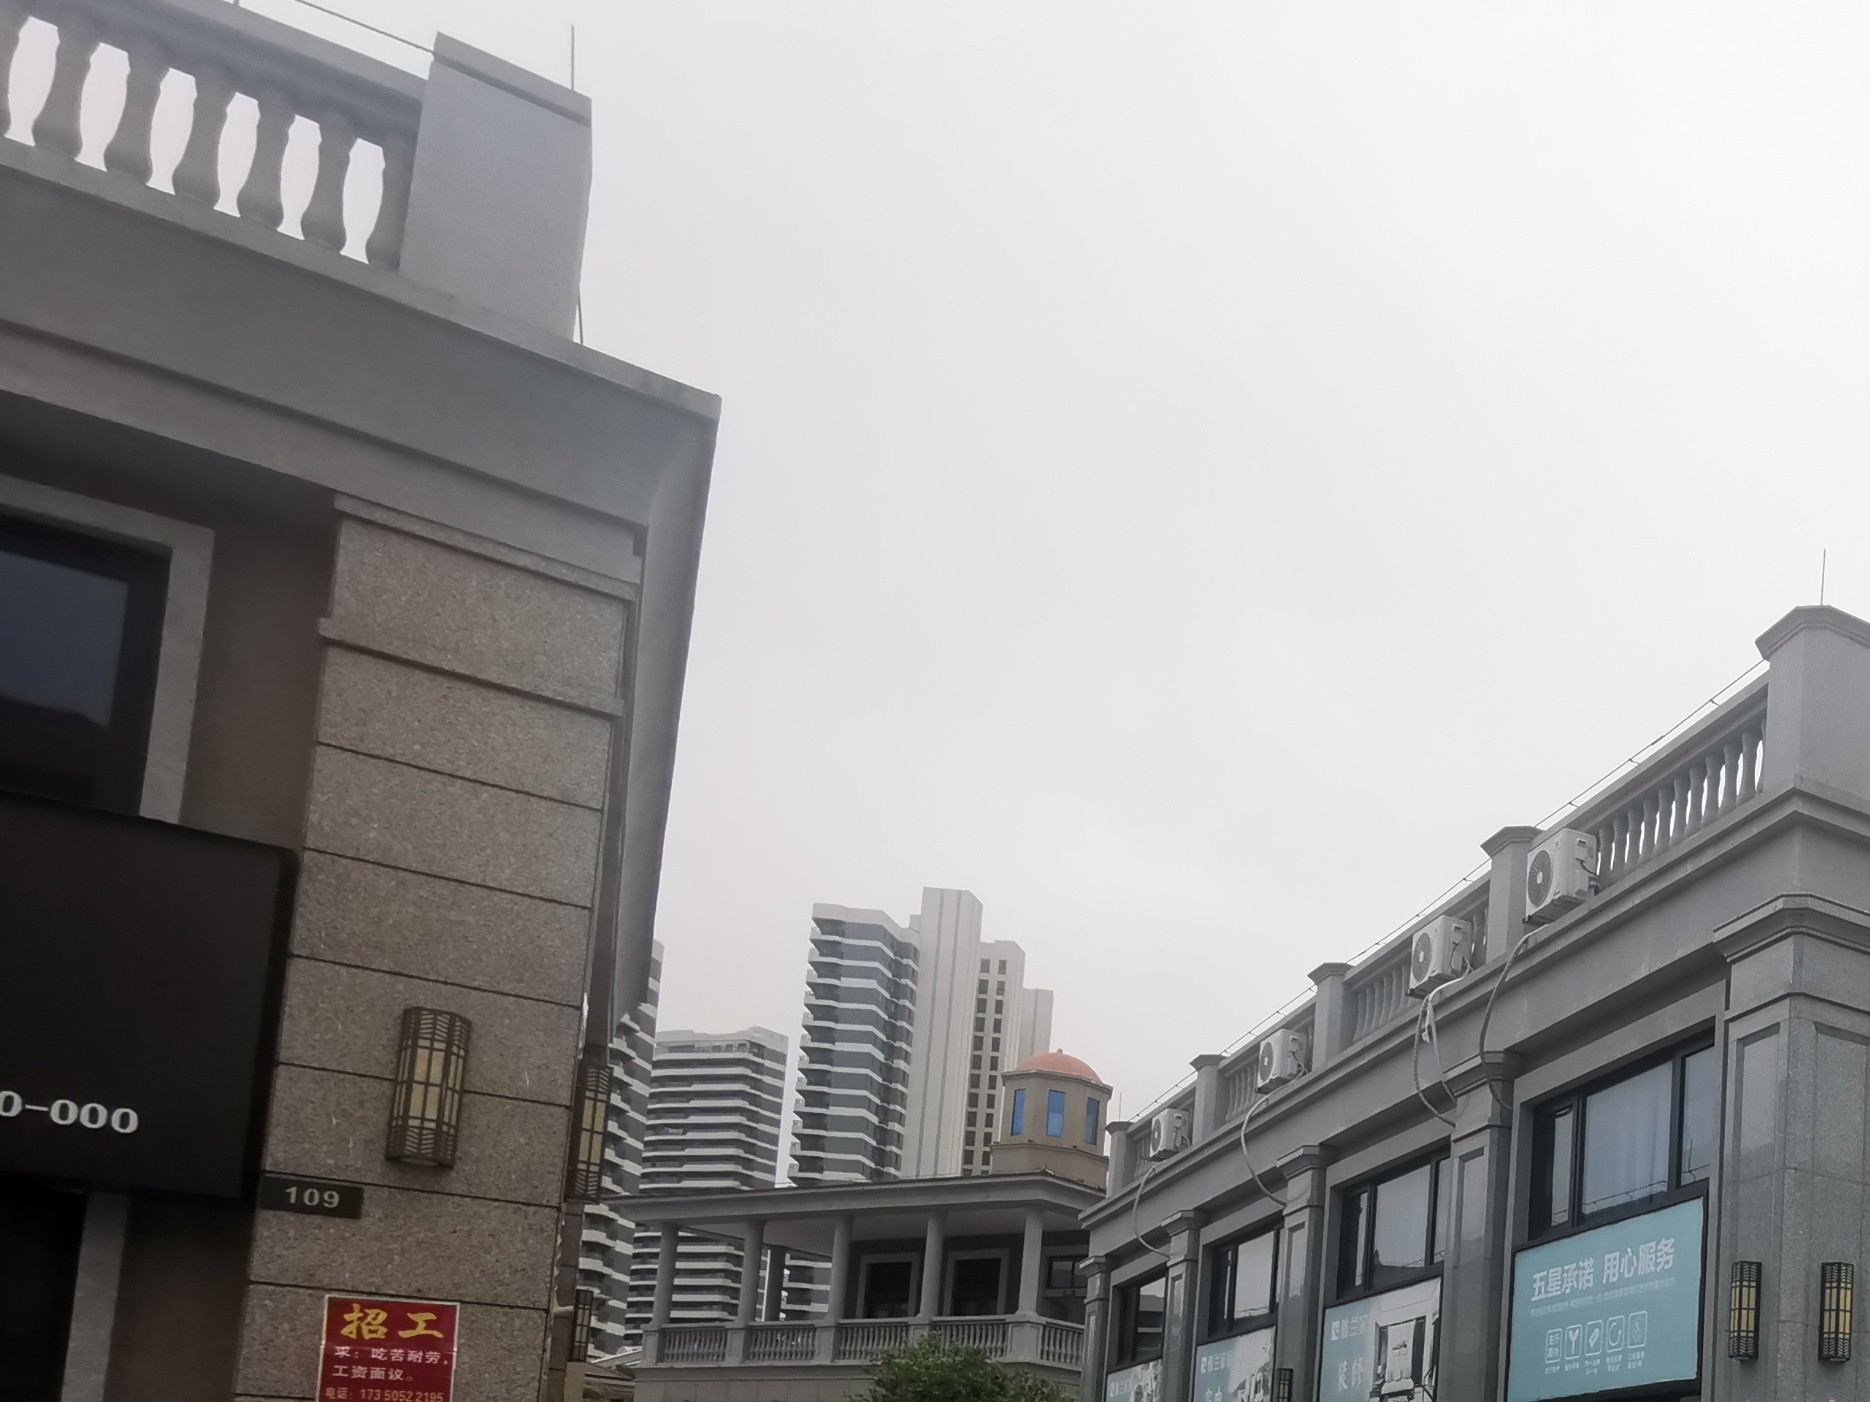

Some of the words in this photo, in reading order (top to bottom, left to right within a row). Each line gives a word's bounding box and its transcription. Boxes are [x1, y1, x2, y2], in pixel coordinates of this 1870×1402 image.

[285, 1186, 339, 1208] 109
[1531, 1257, 1595, 1302] 五星承诺
[1603, 1237, 1676, 1284] 用心服务
[341, 1303, 444, 1339] 招工
[332, 1365, 413, 1382] 工资面议。
